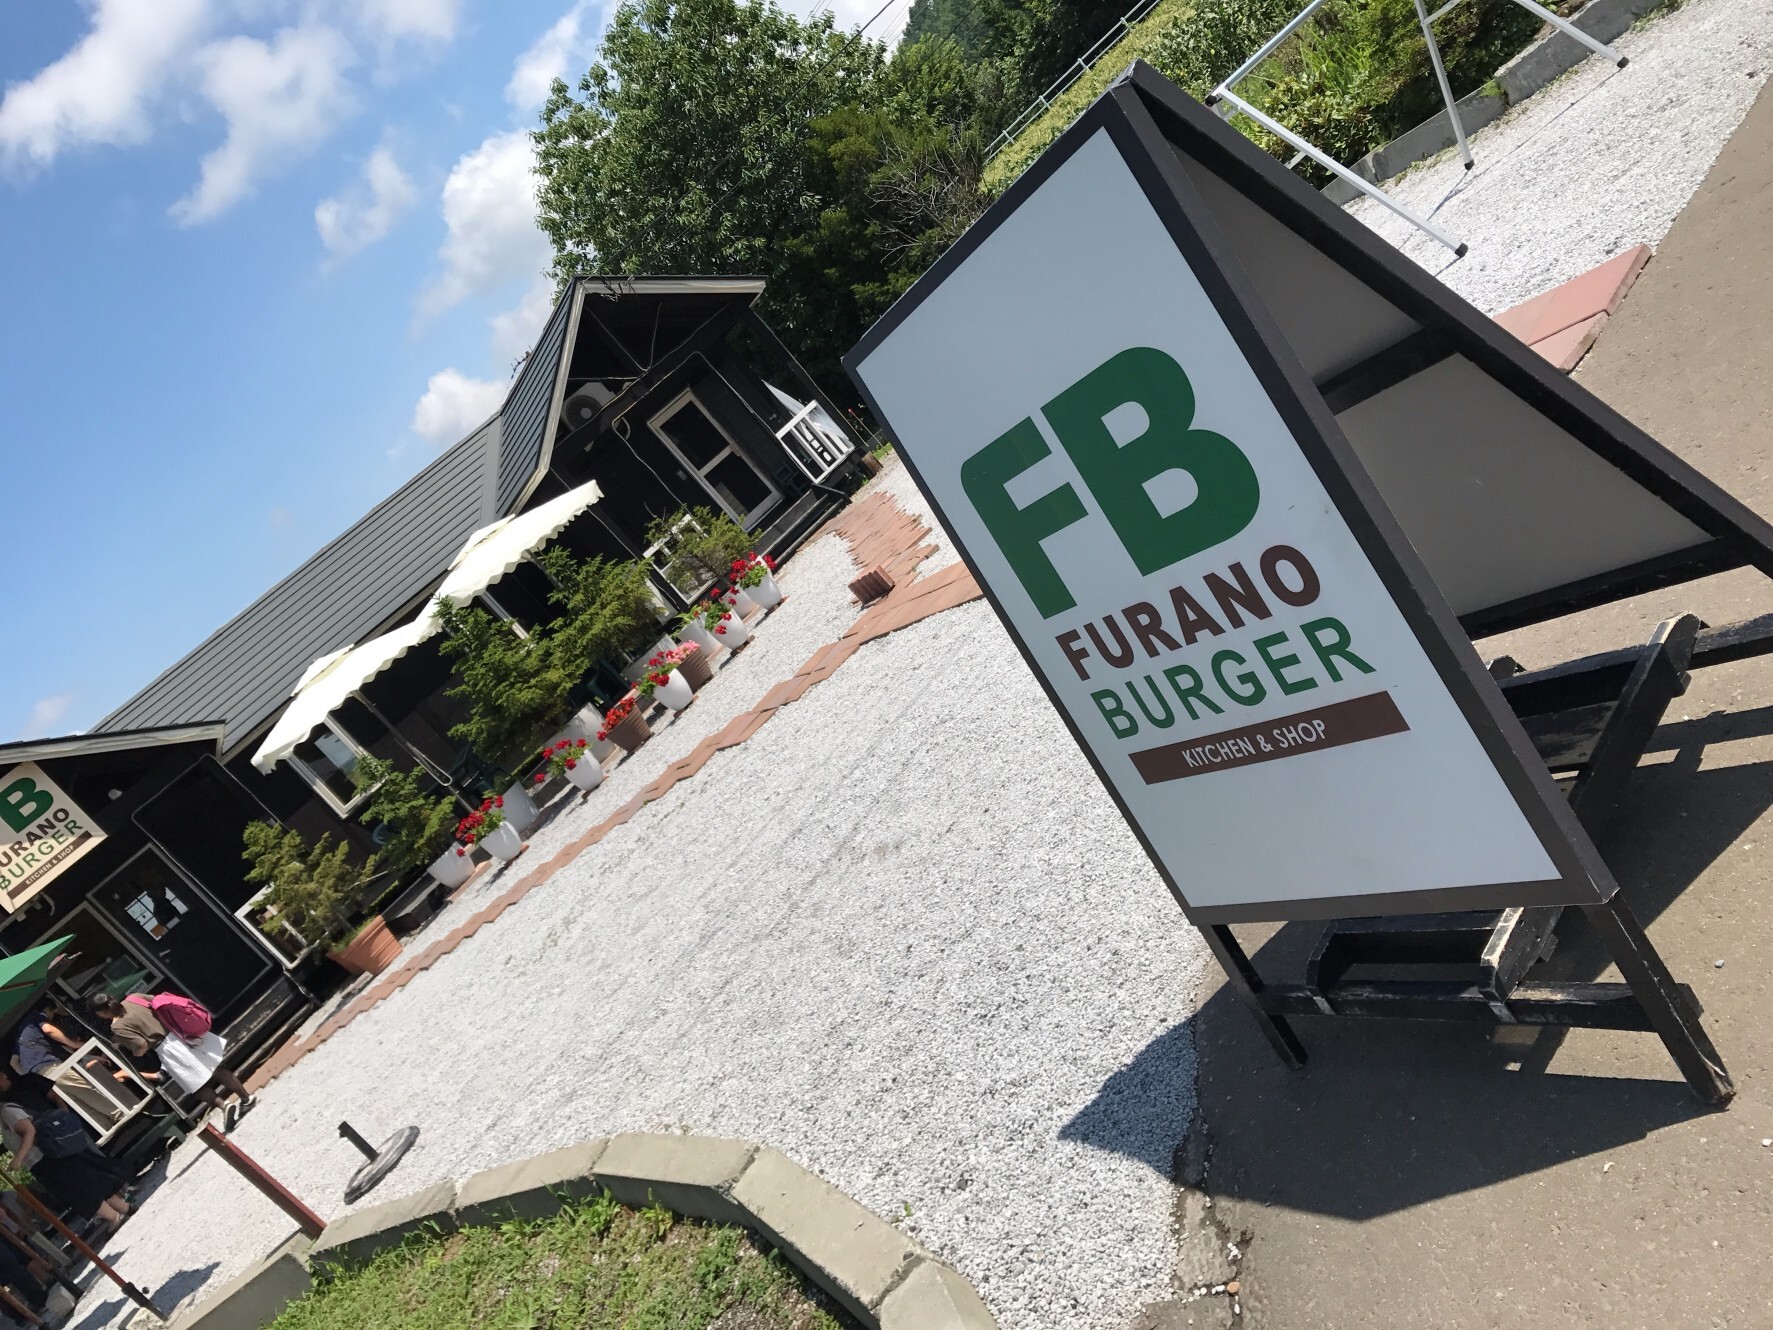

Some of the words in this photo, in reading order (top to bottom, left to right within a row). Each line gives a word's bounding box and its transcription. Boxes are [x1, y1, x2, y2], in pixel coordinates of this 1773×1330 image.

[960, 346, 1260, 620] FB
[1055, 544, 1321, 682] FURANO
[1090, 616, 1377, 740] BURGER
[1181, 736, 1256, 768] KITCHEN
[1256, 734, 1274, 753] &
[1272, 719, 1326, 749] SHOP
[25, 863, 52, 885] KITCHEN
[57, 845, 74, 860] SHOP
